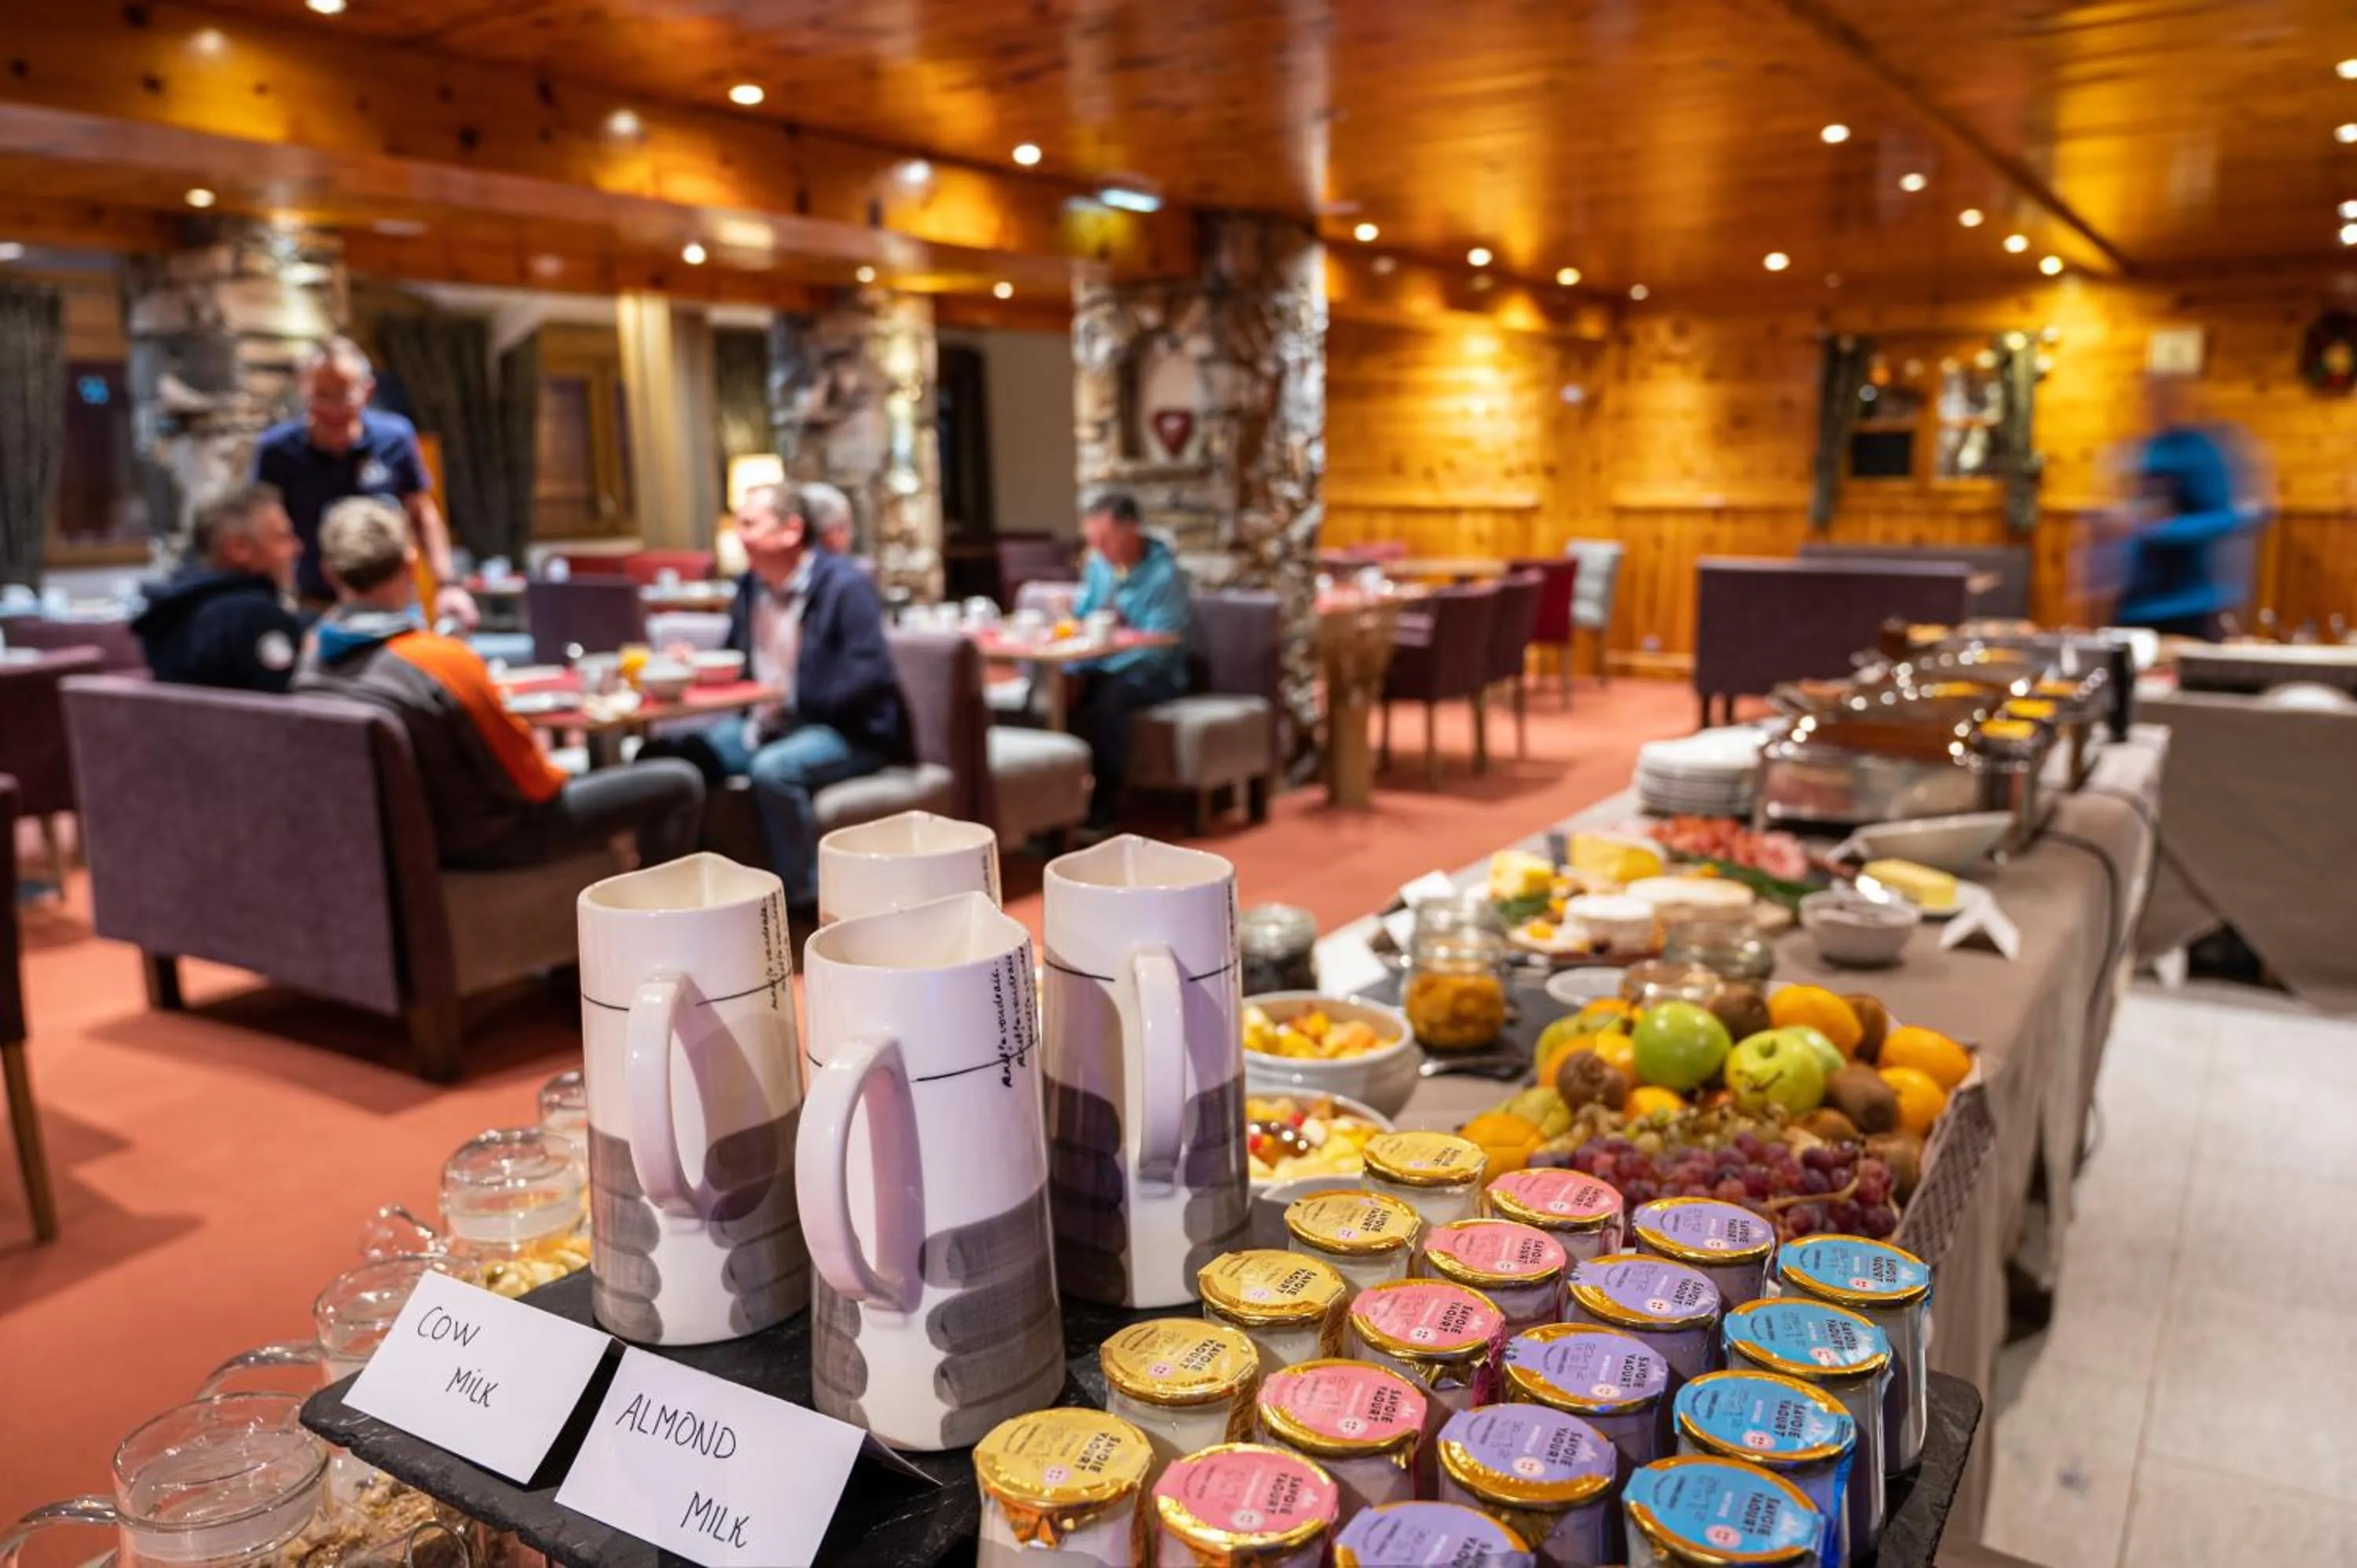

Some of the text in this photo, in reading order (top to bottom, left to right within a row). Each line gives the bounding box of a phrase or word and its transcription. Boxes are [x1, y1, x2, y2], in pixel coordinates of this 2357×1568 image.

[1276, 1269, 1308, 1294] YAOURT
[1286, 1272, 1318, 1295] SAVOIE
[417, 1306, 481, 1346] COW
[1439, 1302, 1462, 1332] YAOURT
[1450, 1305, 1473, 1334] SAVOIE
[1178, 1339, 1217, 1369] YAOURT
[1190, 1343, 1226, 1371] SAVOIE
[1619, 1354, 1637, 1388] YAOURT
[1633, 1357, 1649, 1388] SAVOIE
[1367, 1387, 1387, 1422] YAOURT
[1380, 1390, 1402, 1423] SAVOIE
[1773, 1400, 1791, 1437] YAOURT
[1787, 1403, 1806, 1438] SAVOIE
[616, 1393, 737, 1459] ALMOND
[1074, 1432, 1110, 1471] YAOURT
[1087, 1434, 1122, 1474] SAVOIE
[1546, 1427, 1570, 1465] YAOURT
[1559, 1431, 1583, 1467] SAVOIE
[1264, 1472, 1289, 1515] YAOURT
[1278, 1476, 1303, 1515] SAVOIE
[680, 1491, 750, 1548] MILK
[1740, 1492, 1764, 1534] YAOURT
[1756, 1497, 1781, 1537] SAVOIE
